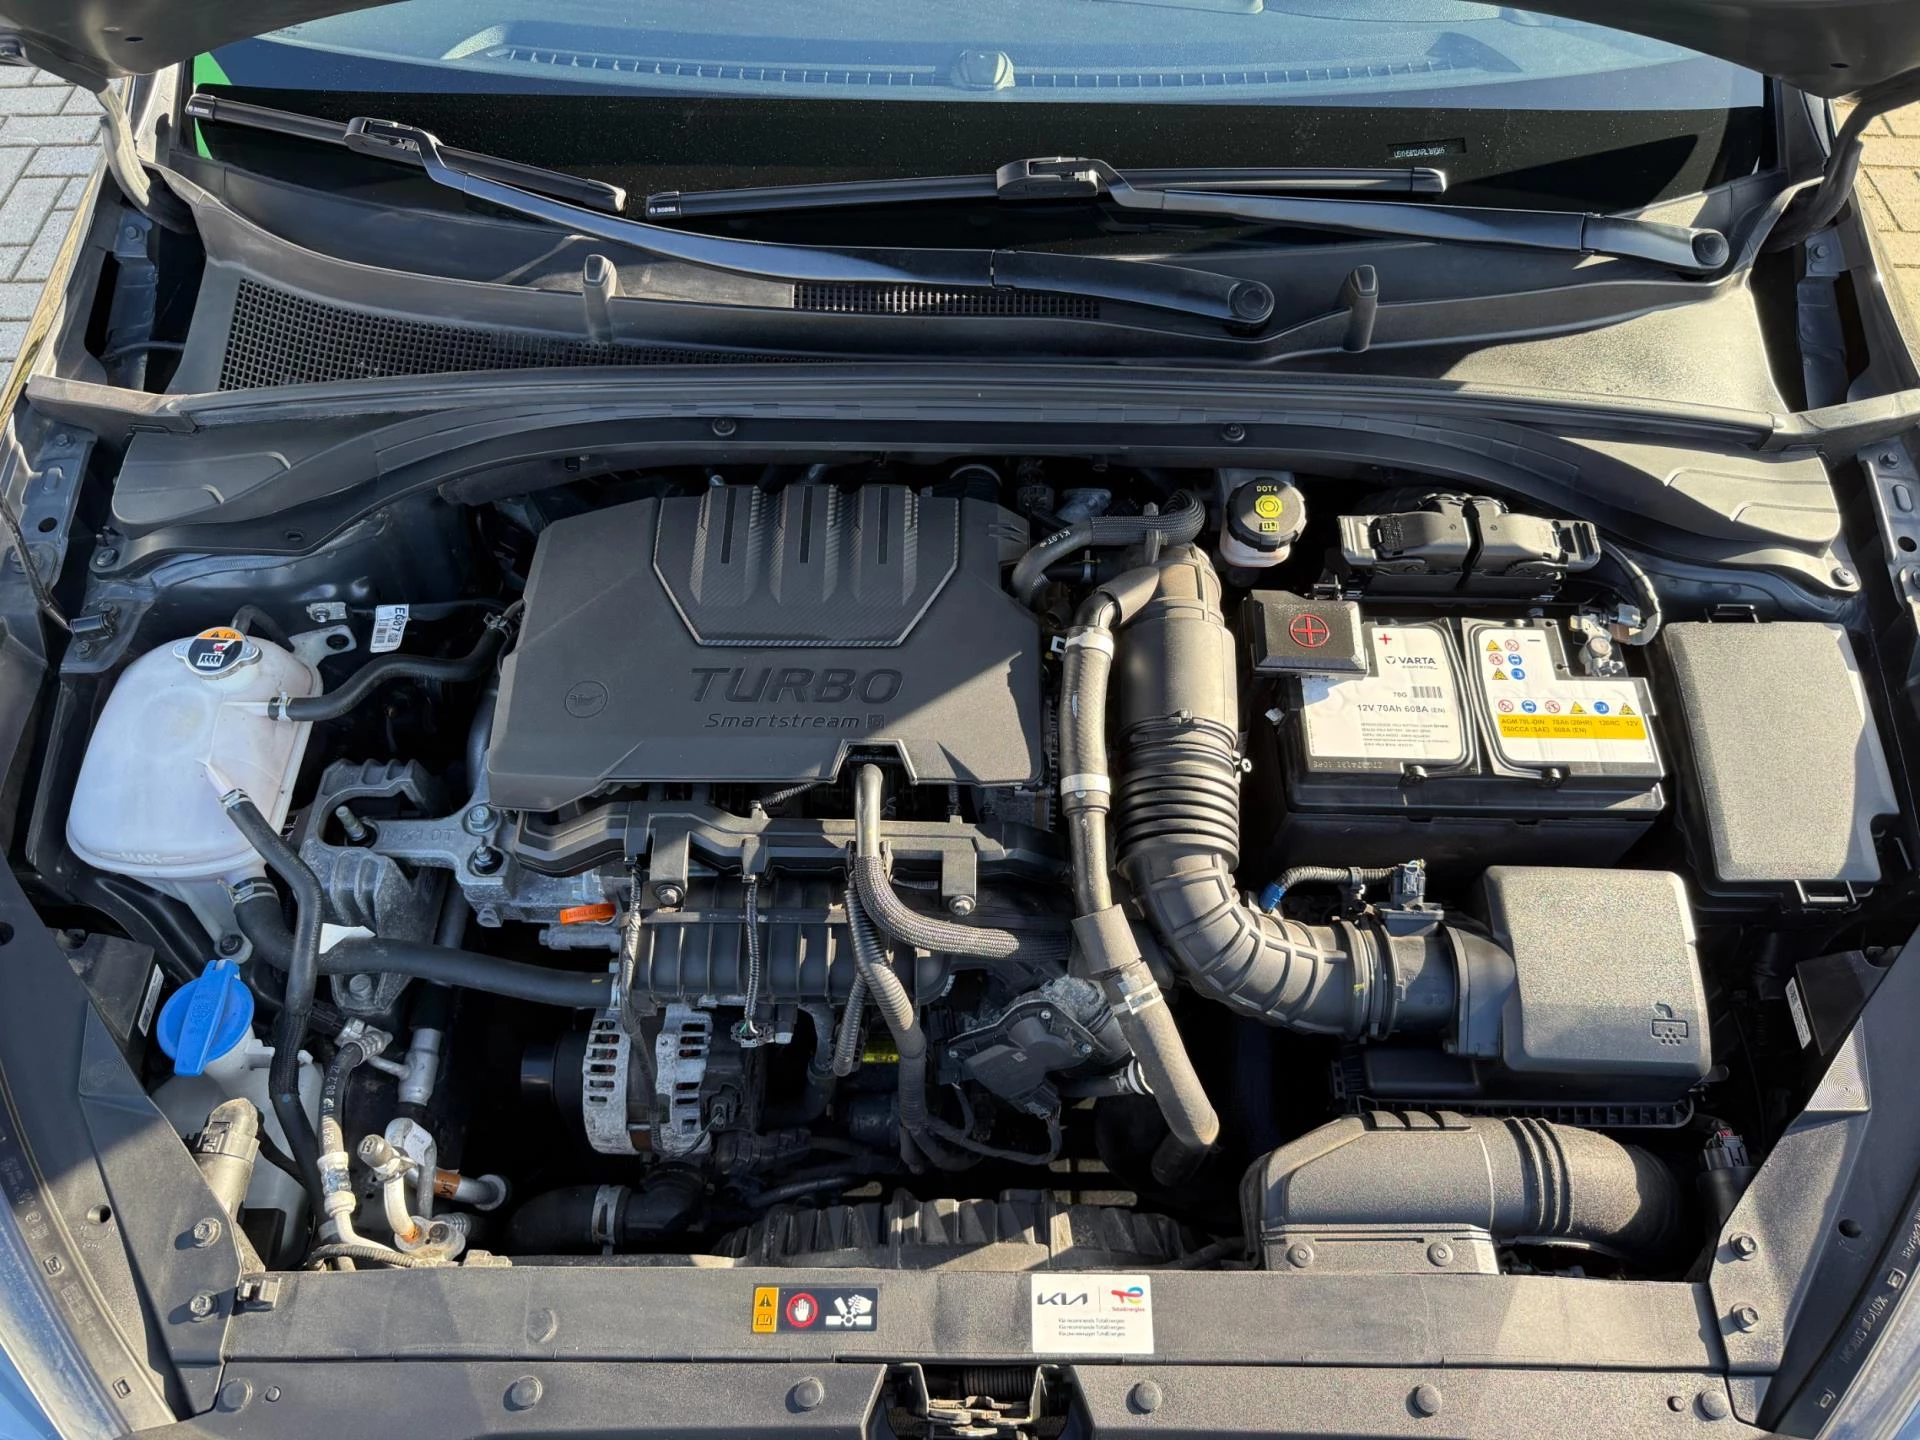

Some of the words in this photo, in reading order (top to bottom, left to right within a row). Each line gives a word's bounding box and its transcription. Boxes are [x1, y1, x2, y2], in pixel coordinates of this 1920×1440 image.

[1400, 656, 1436, 664] VARTA
[688, 666, 904, 704] TURBO
[1358, 704, 1375, 712] 12V
[1378, 704, 1402, 712] 70Ah
[1404, 705, 1429, 713] 608A
[704, 713, 860, 728] Smartstream
[1037, 1292, 1088, 1306] KIA
